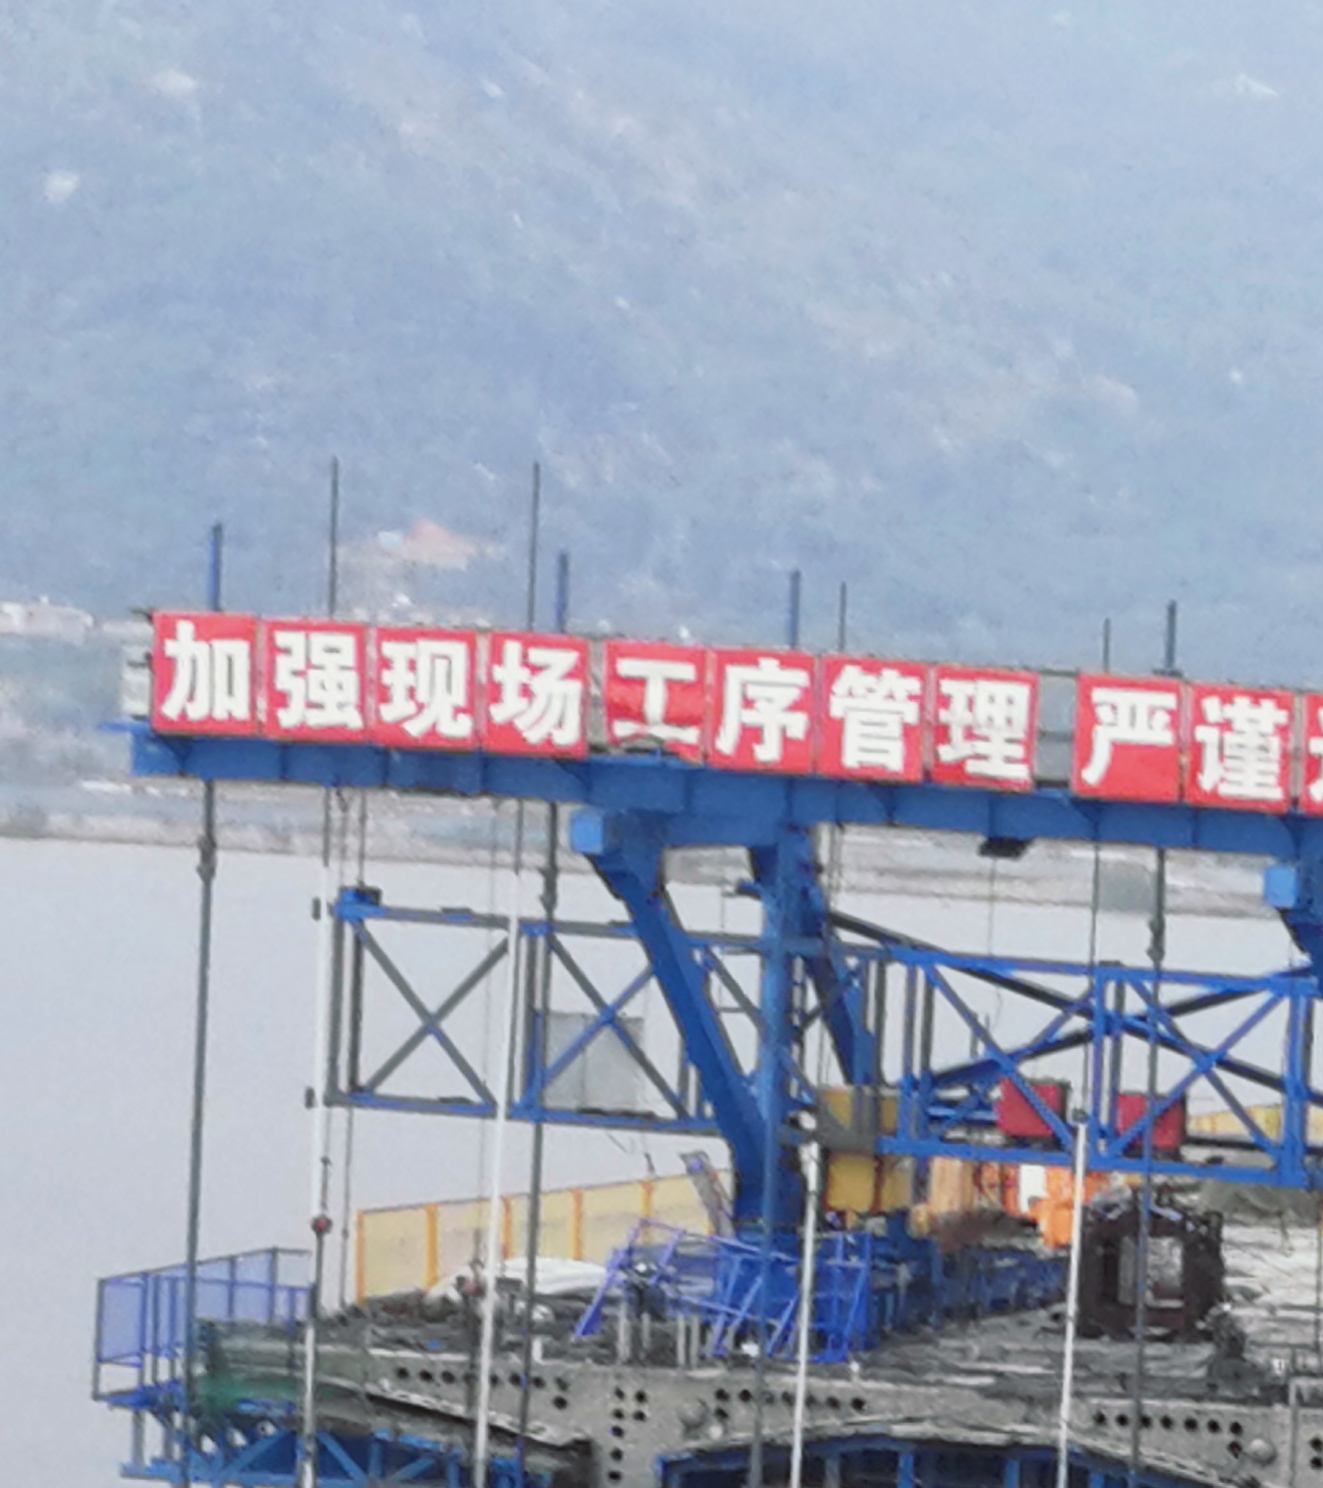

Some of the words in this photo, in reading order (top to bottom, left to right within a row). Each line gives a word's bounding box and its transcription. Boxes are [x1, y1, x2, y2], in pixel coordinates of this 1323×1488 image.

[162, 620, 1032, 782] 加强现场工序管理
